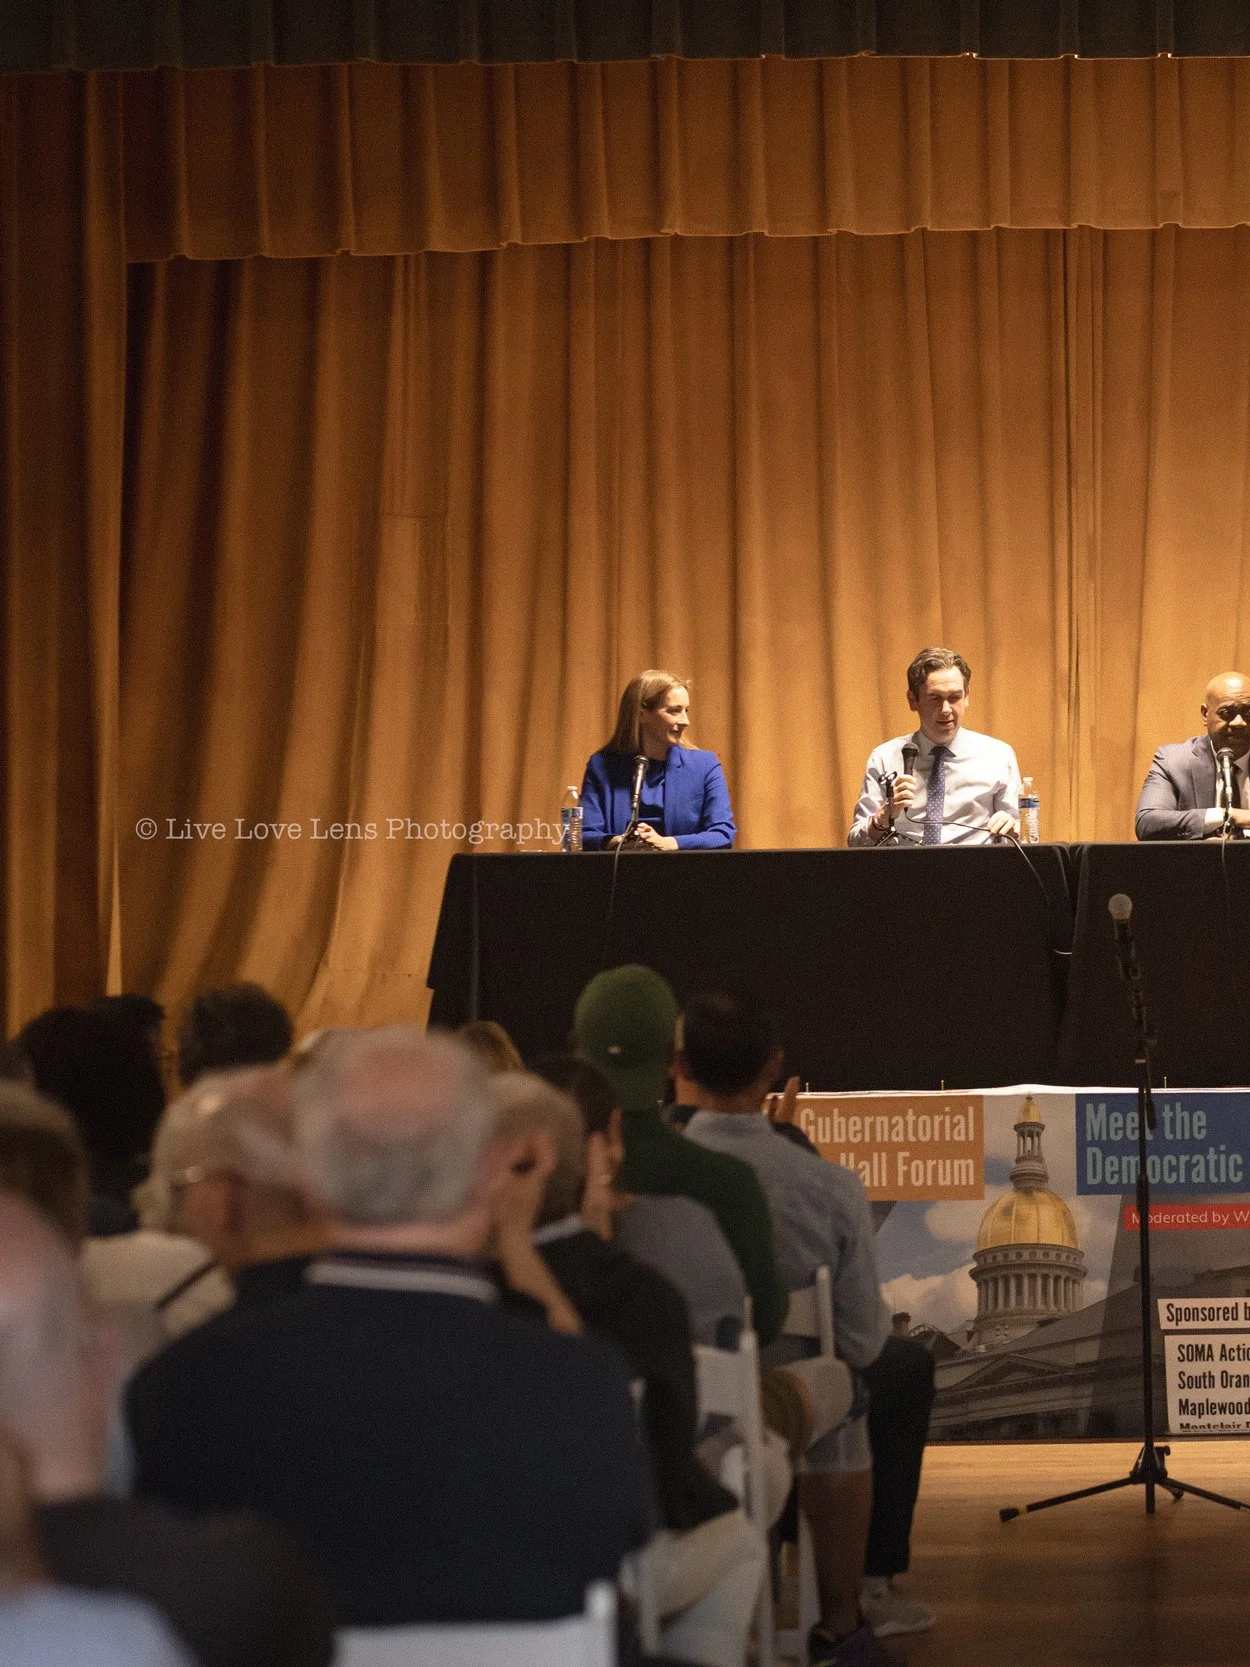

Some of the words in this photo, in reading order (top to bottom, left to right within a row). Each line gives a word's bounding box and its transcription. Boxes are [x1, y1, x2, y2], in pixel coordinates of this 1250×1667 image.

[800, 1106, 975, 1144] Gubernatorial
[1162, 1102, 1207, 1140] the
[897, 1151, 975, 1187] Forum
[1086, 1145, 1244, 1185] Democratic
[1132, 1211, 1208, 1225] Moderated
[1212, 1211, 1230, 1226] by
[1166, 1302, 1239, 1326] Sponsored
[1177, 1343, 1214, 1363] SOMA
[1177, 1370, 1216, 1390] South
